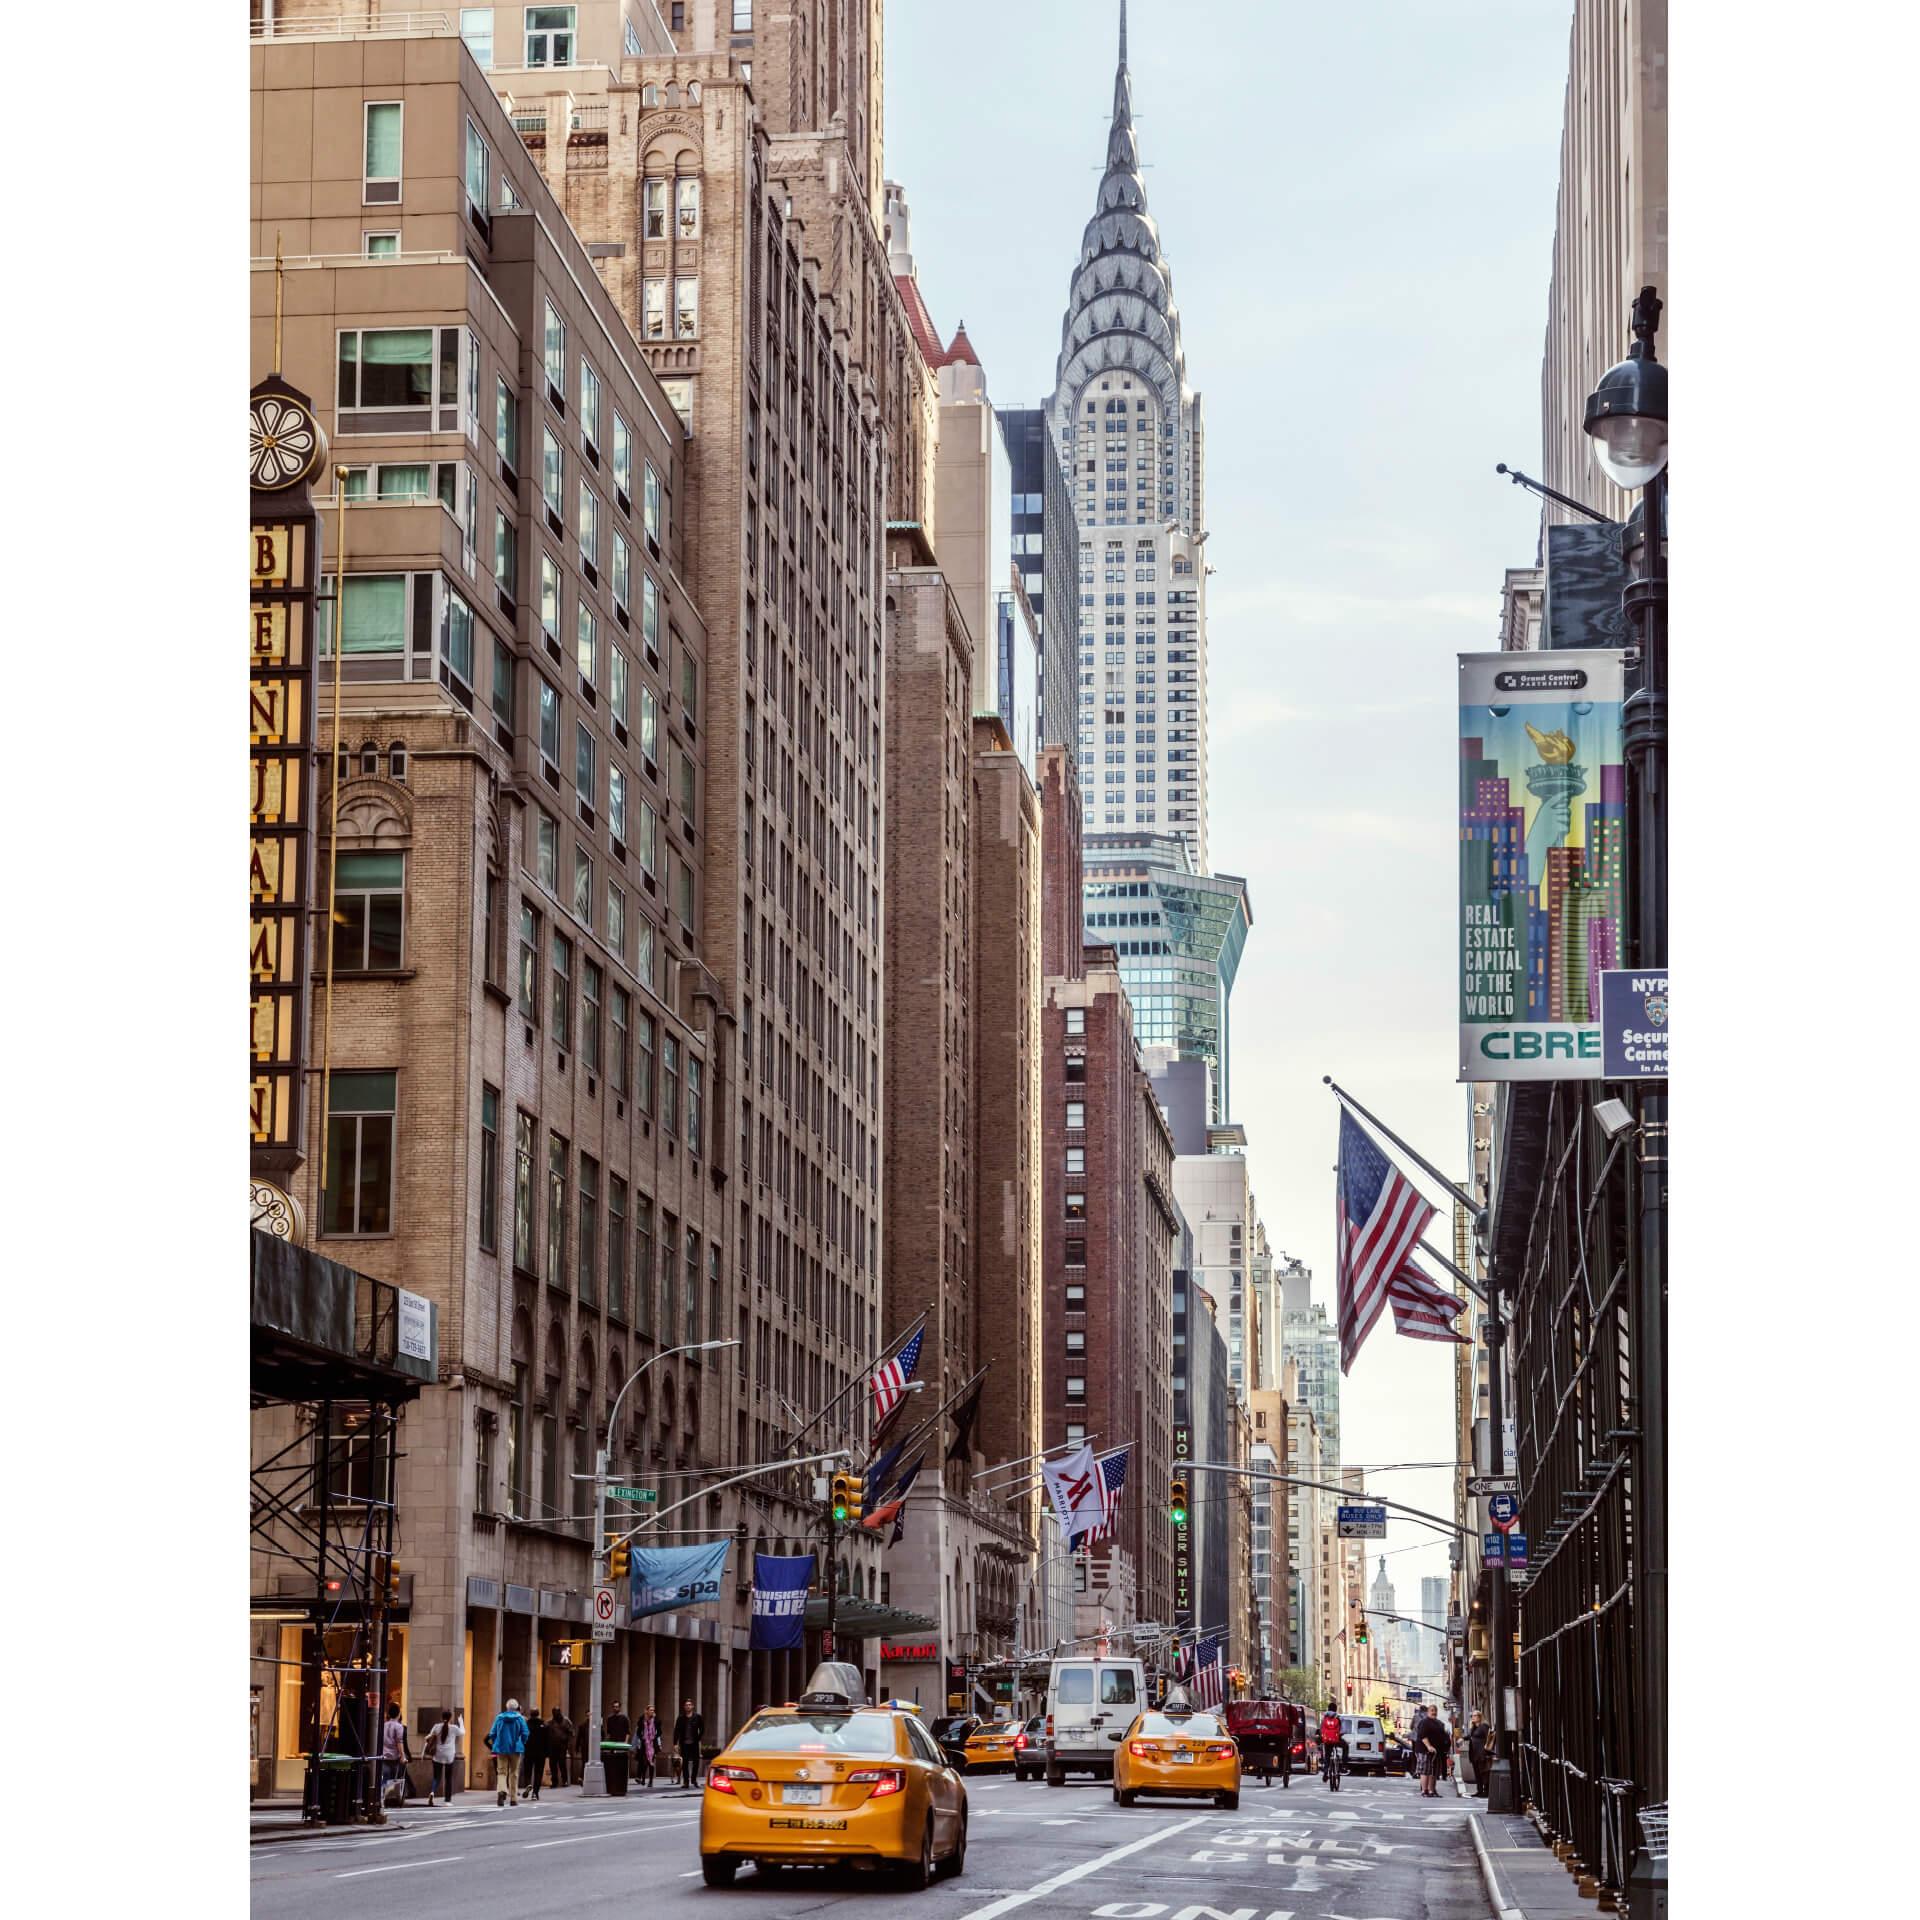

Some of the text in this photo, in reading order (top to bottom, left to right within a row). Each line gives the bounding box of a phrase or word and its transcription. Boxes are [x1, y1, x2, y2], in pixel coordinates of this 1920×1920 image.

[1465, 905, 1500, 925] REAL
[1465, 928, 1515, 948] ESTATE
[1465, 950, 1523, 971] CAPITAL
[1465, 973, 1513, 993] OF THE
[1465, 996, 1514, 1016] WORLD
[1480, 1031, 1601, 1060] CBRE
[1640, 1064, 1651, 1073] In
[1176, 1430, 1189, 1481] HOTE
[1474, 1482, 1518, 1491] ONE WA
[1054, 1482, 1071, 1526] MARRIOTT
[677, 1580, 719, 1600] spa
[1176, 1557, 1188, 1608] SMITH
[1209, 1834, 1416, 1855] ONLY
